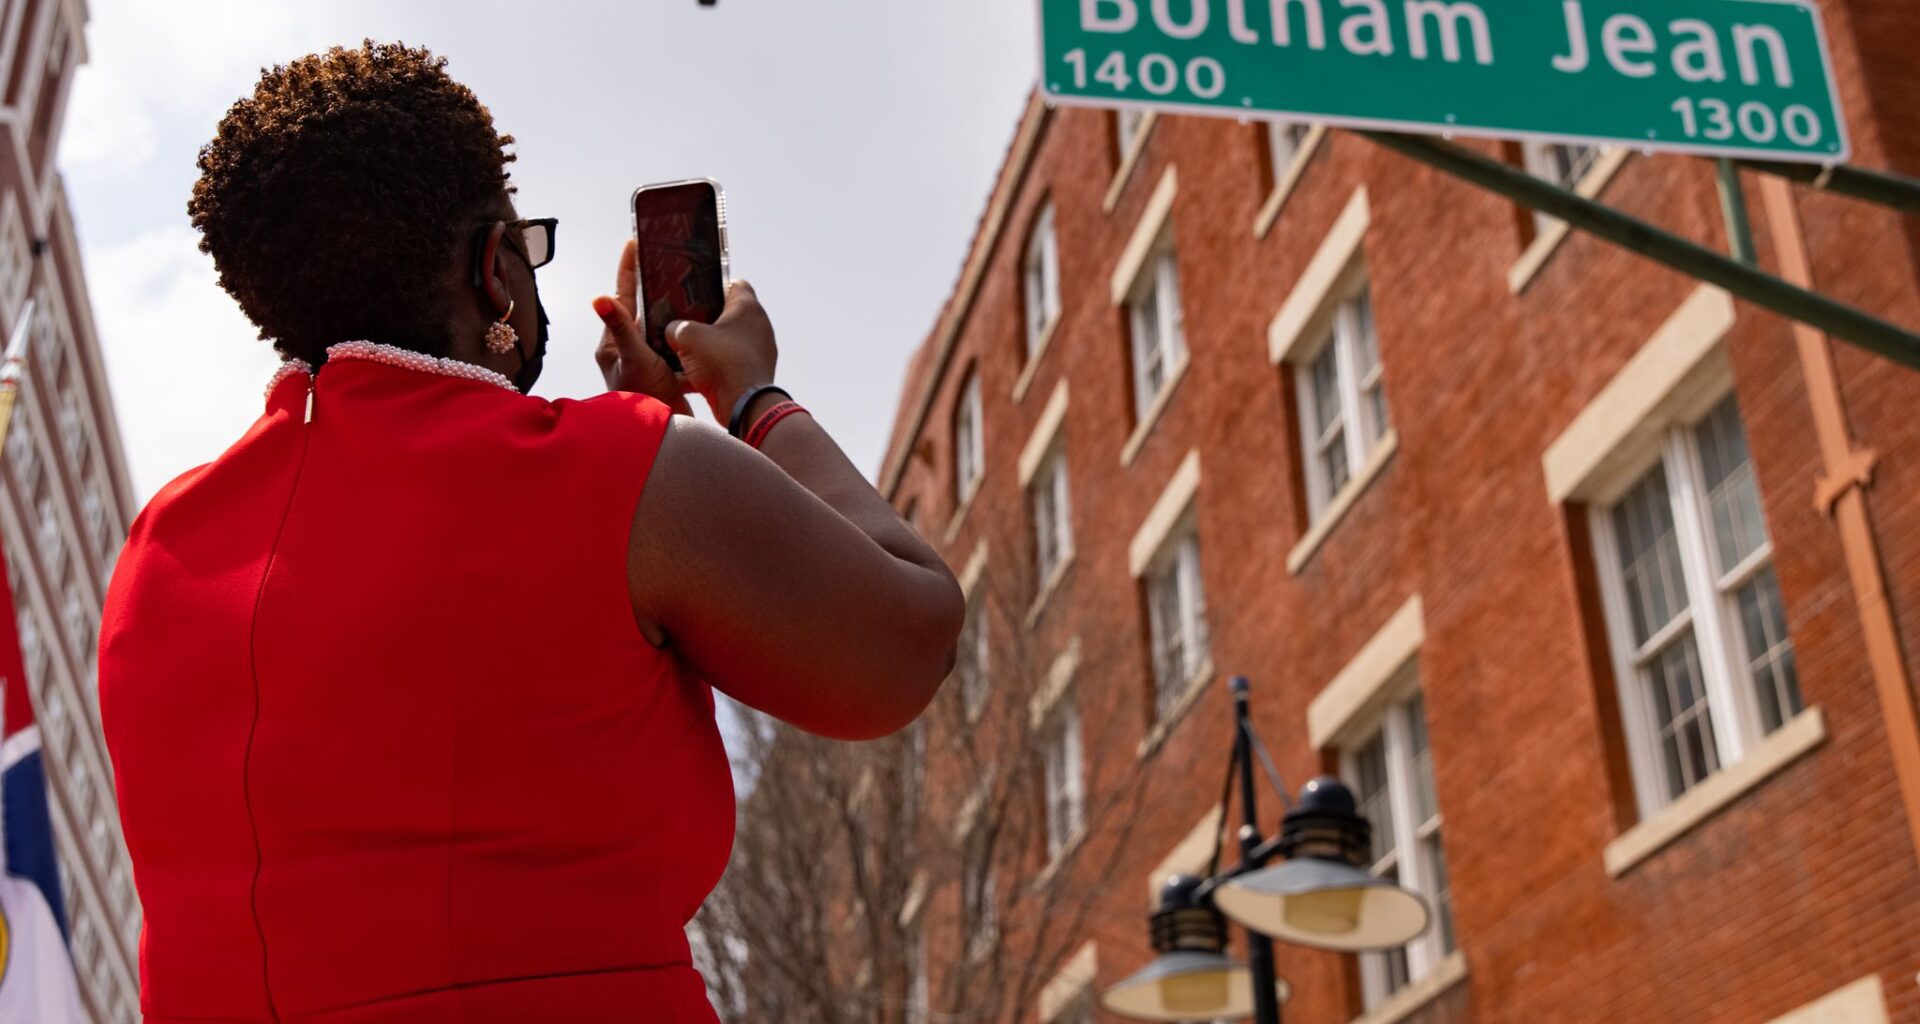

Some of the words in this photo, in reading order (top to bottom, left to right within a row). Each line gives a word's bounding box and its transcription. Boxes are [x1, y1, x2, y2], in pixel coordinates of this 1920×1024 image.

[1552, 0, 1793, 88] Jean
[1064, 48, 1225, 98] 1400
[1672, 97, 1821, 146] 1300
